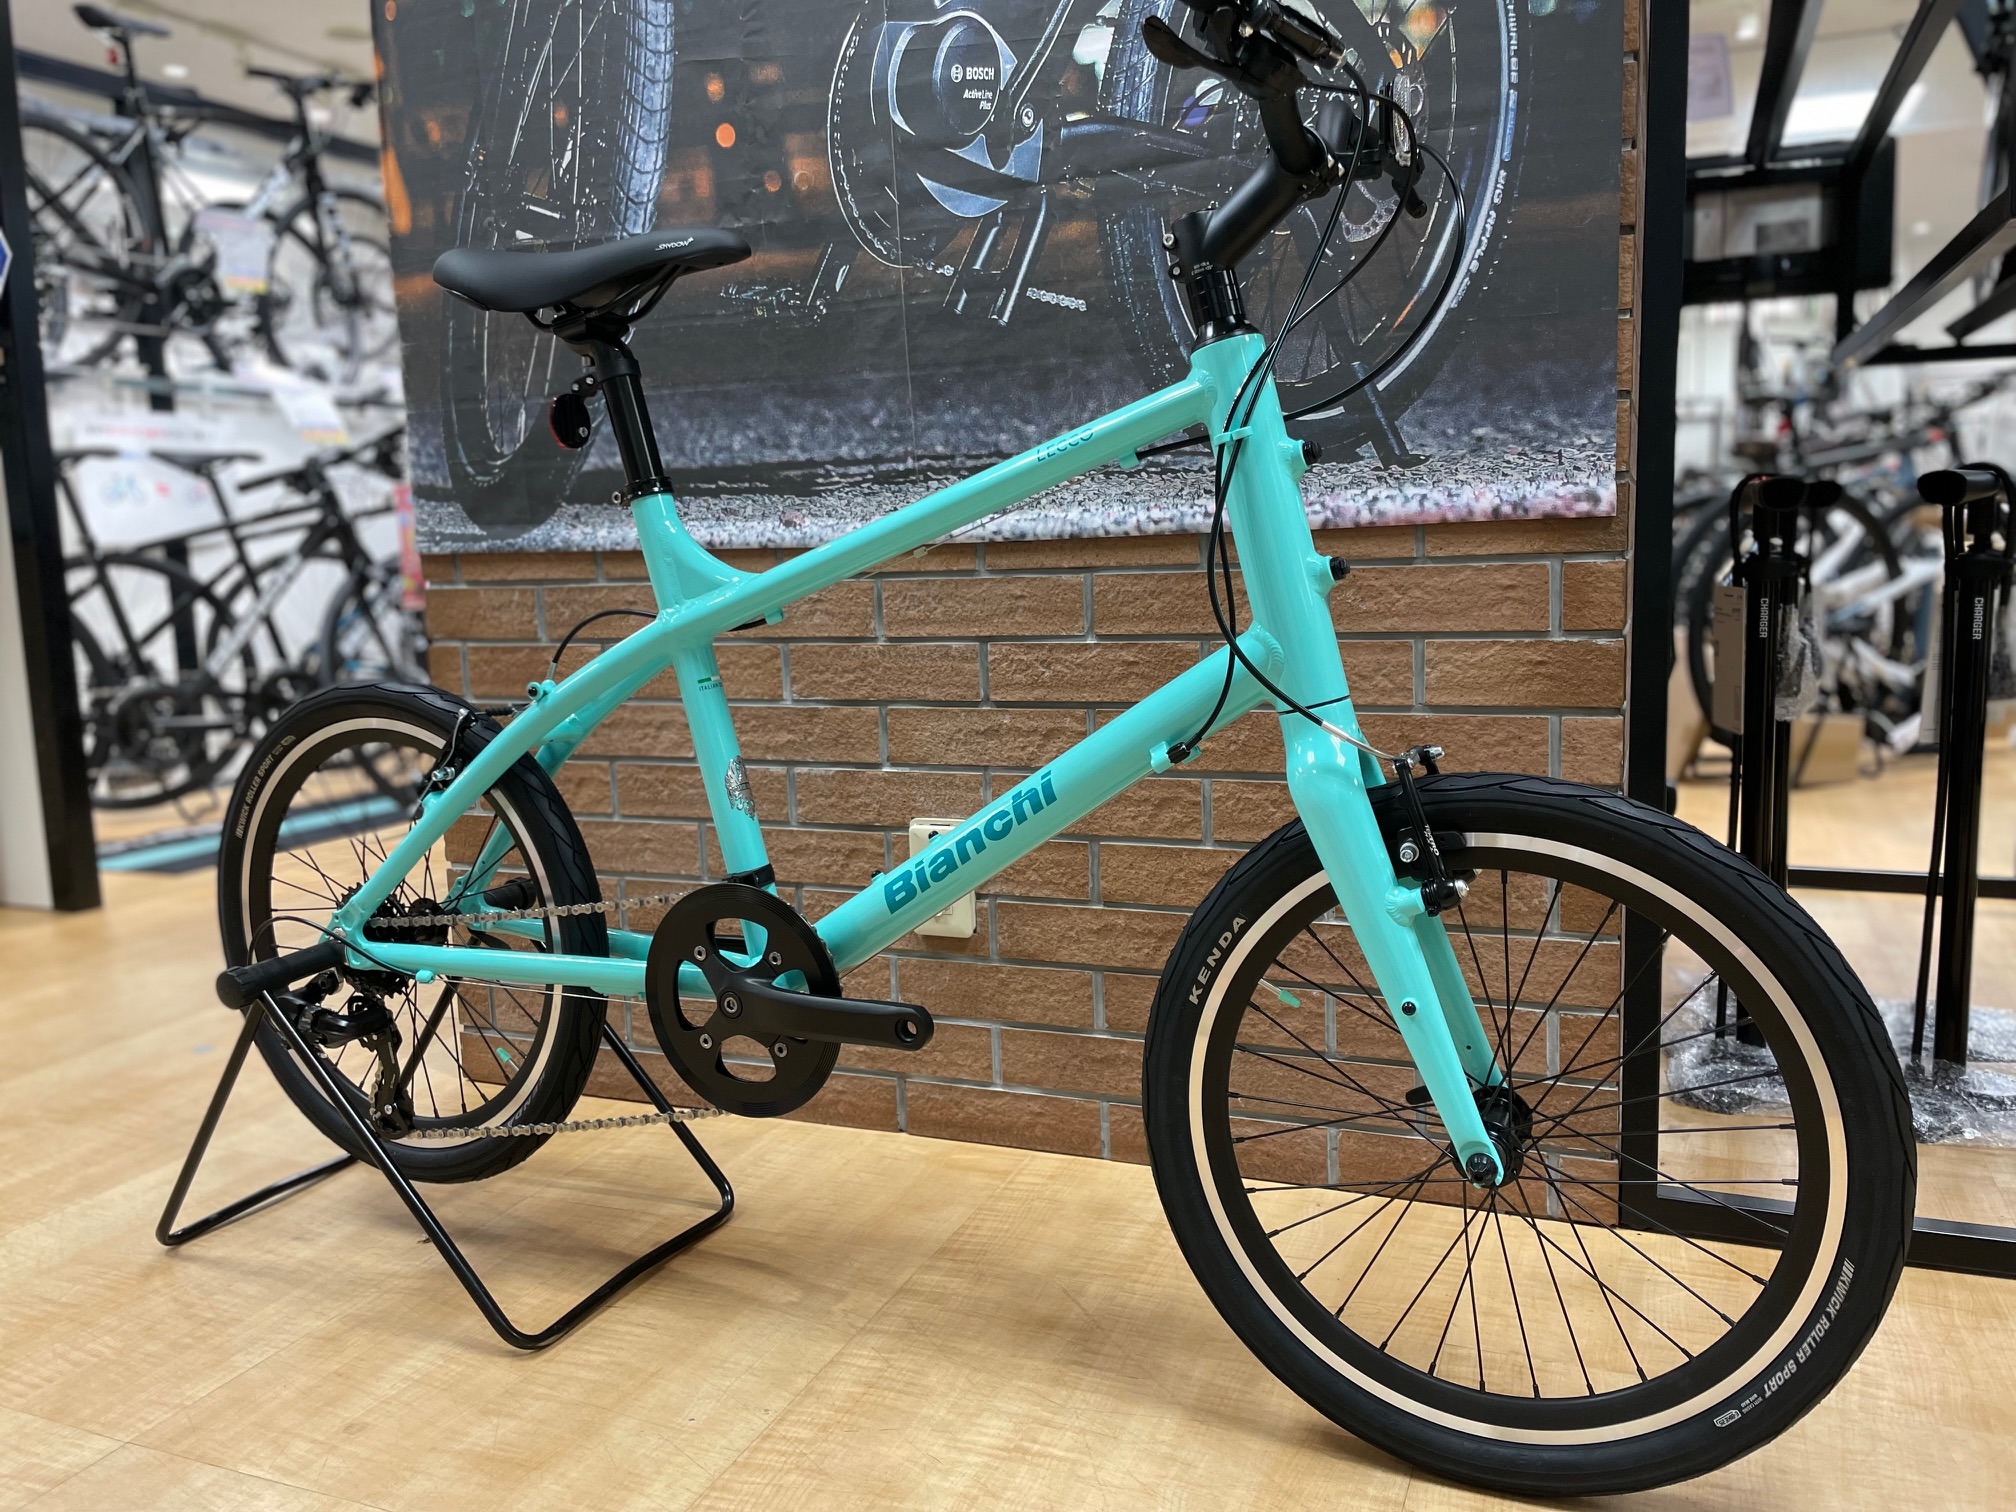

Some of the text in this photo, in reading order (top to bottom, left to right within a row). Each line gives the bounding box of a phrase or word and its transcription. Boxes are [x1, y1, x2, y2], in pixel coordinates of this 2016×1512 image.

[966, 66, 995, 80] BOSCH
[1037, 428, 1094, 462] LECCO
[1759, 598, 1769, 638] CHARGER
[1972, 597, 1984, 640] CHARGER
[257, 754, 274, 777] SPORT
[884, 769, 1057, 915] Bianchi
[1189, 917, 1247, 1005] KENDA
[1763, 1275, 1852, 1398] KWICK ROLLER SPORT
